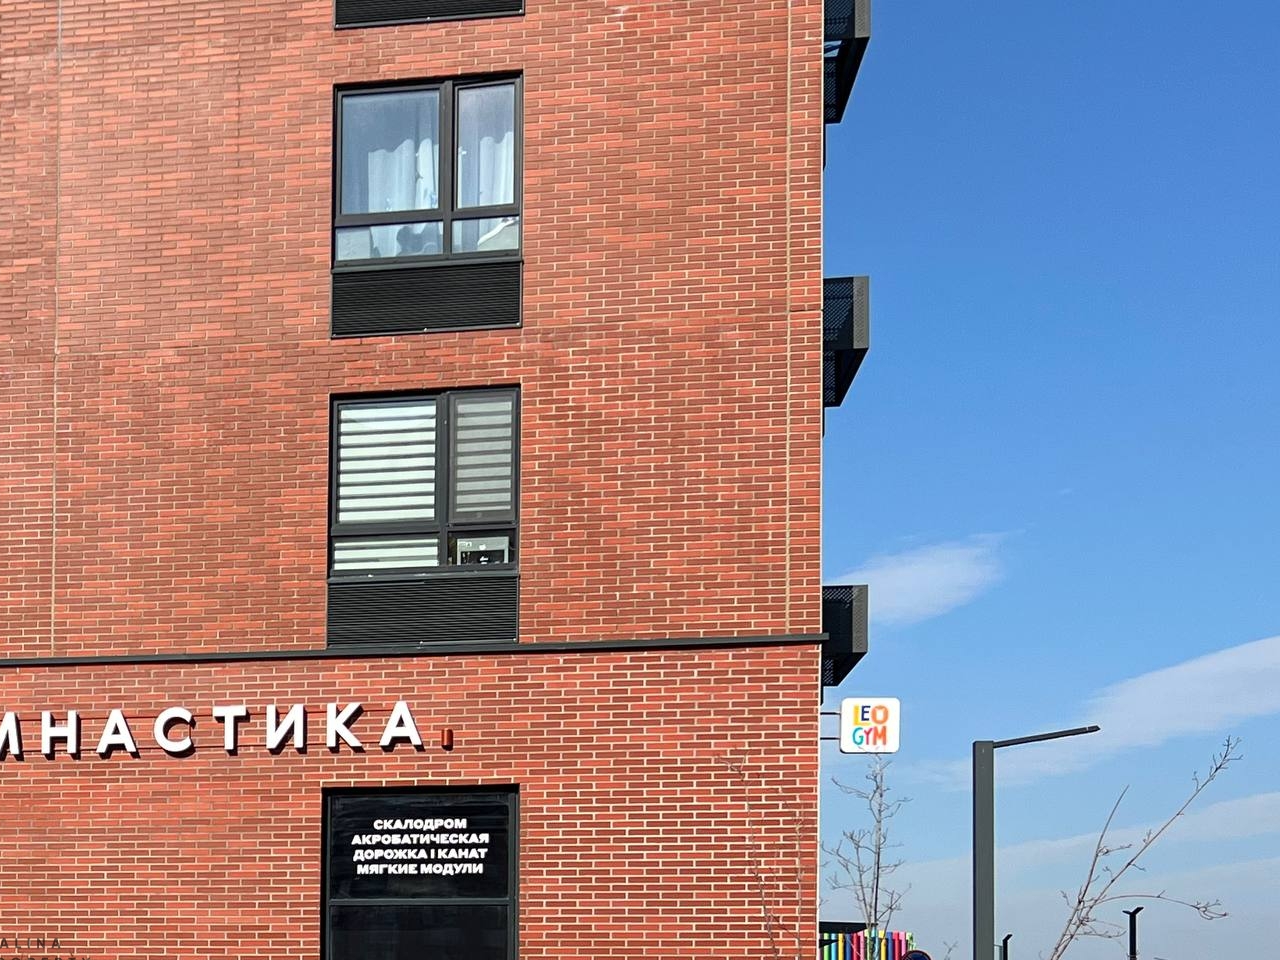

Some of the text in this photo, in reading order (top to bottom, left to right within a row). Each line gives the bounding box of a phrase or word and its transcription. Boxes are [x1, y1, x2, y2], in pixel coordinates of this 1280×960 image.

[852, 705, 889, 726] LEO
[852, 726, 887, 746] GYM
[373, 818, 468, 831] СКАЛОДРОМ
[350, 833, 490, 846] АКРОБАТИЧЕСКАЯ
[352, 848, 428, 862] ДОРОЖКА
[437, 847, 489, 860] КАНАТ
[356, 862, 484, 876] МЯГКИЕ МОДУЛИ
